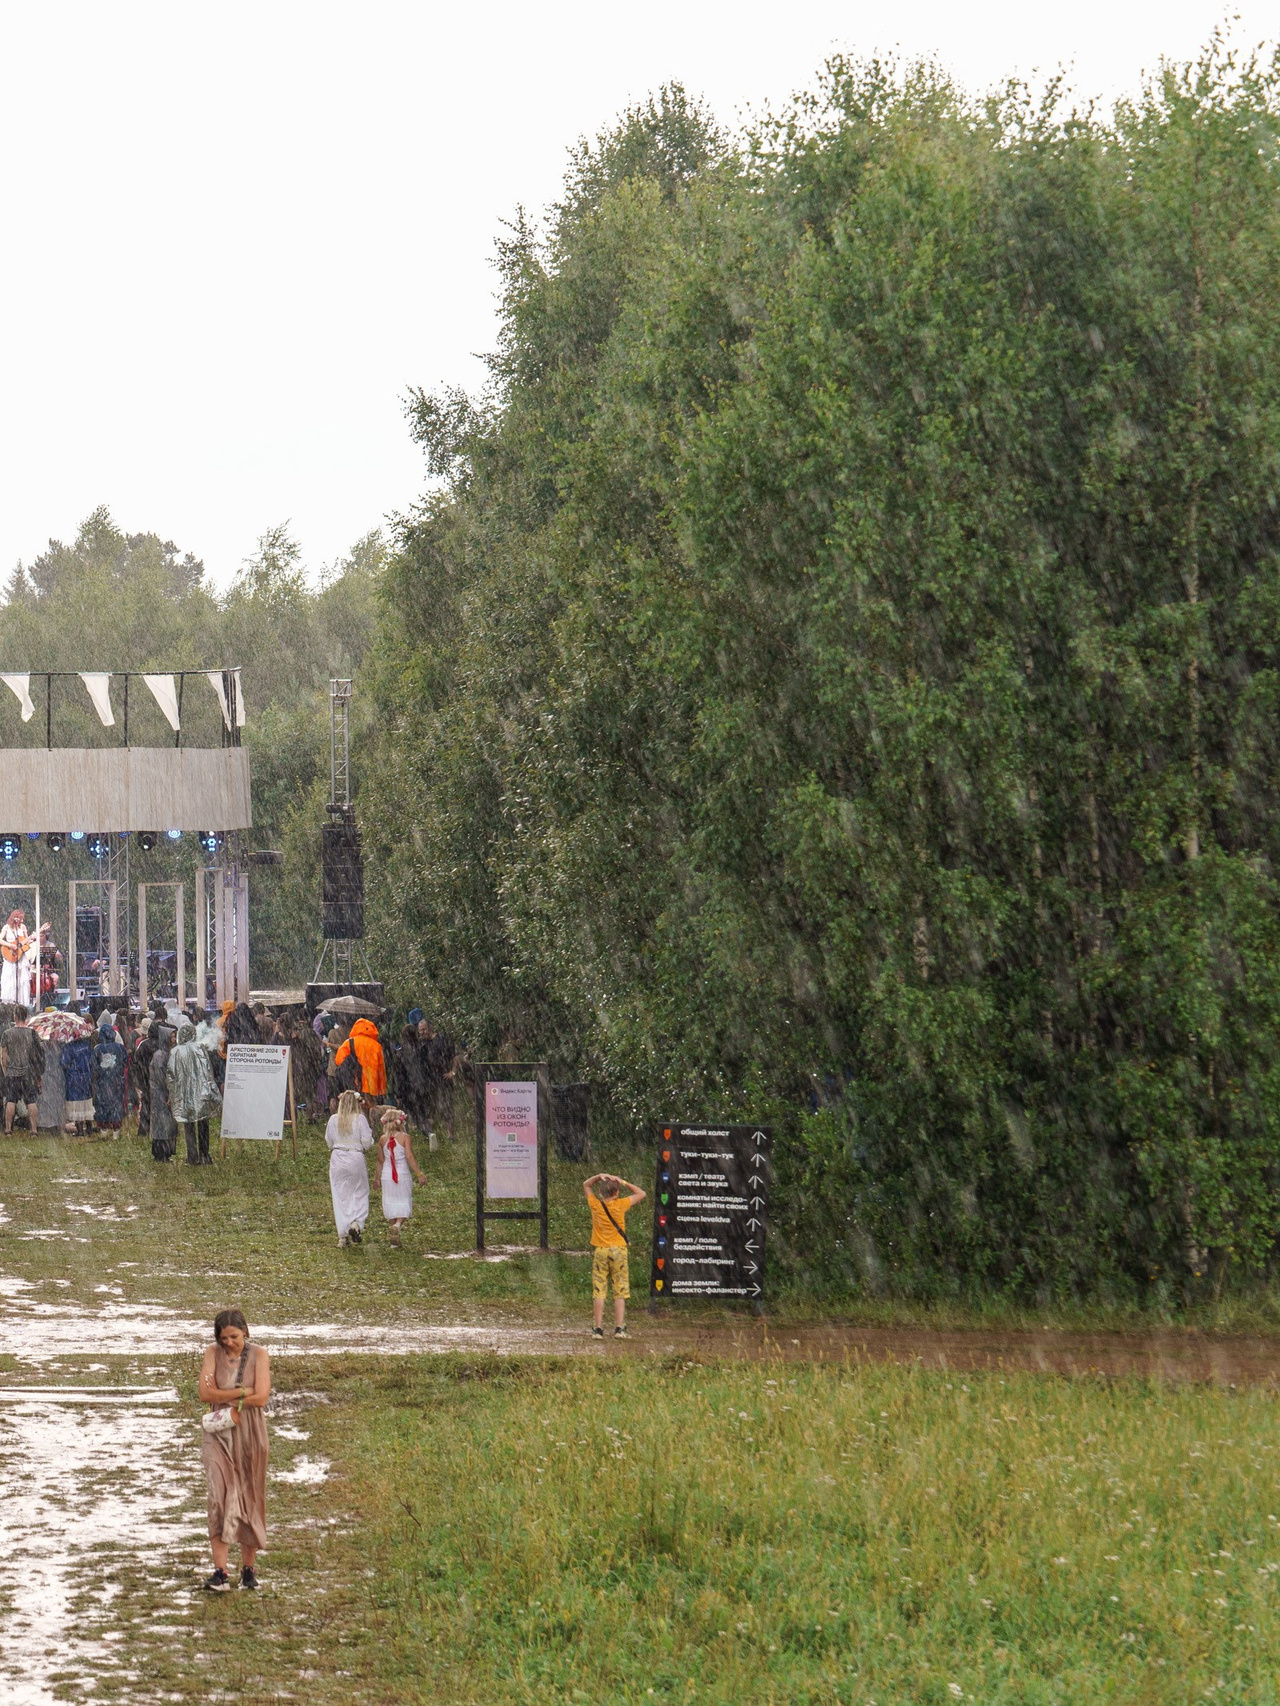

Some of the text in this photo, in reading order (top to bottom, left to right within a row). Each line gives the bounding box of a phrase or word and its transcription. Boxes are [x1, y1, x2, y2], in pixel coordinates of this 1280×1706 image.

[680, 1128, 707, 1136] общий
[680, 1151, 735, 1159] туки-туки-тук
[711, 1195, 748, 1203] исследо-
[700, 1215, 731, 1223] leveldva
[673, 1243, 723, 1251] бездействия
[672, 1257, 735, 1265] город-лабиринт
[672, 1287, 747, 1295] инсекто-фаланстер
